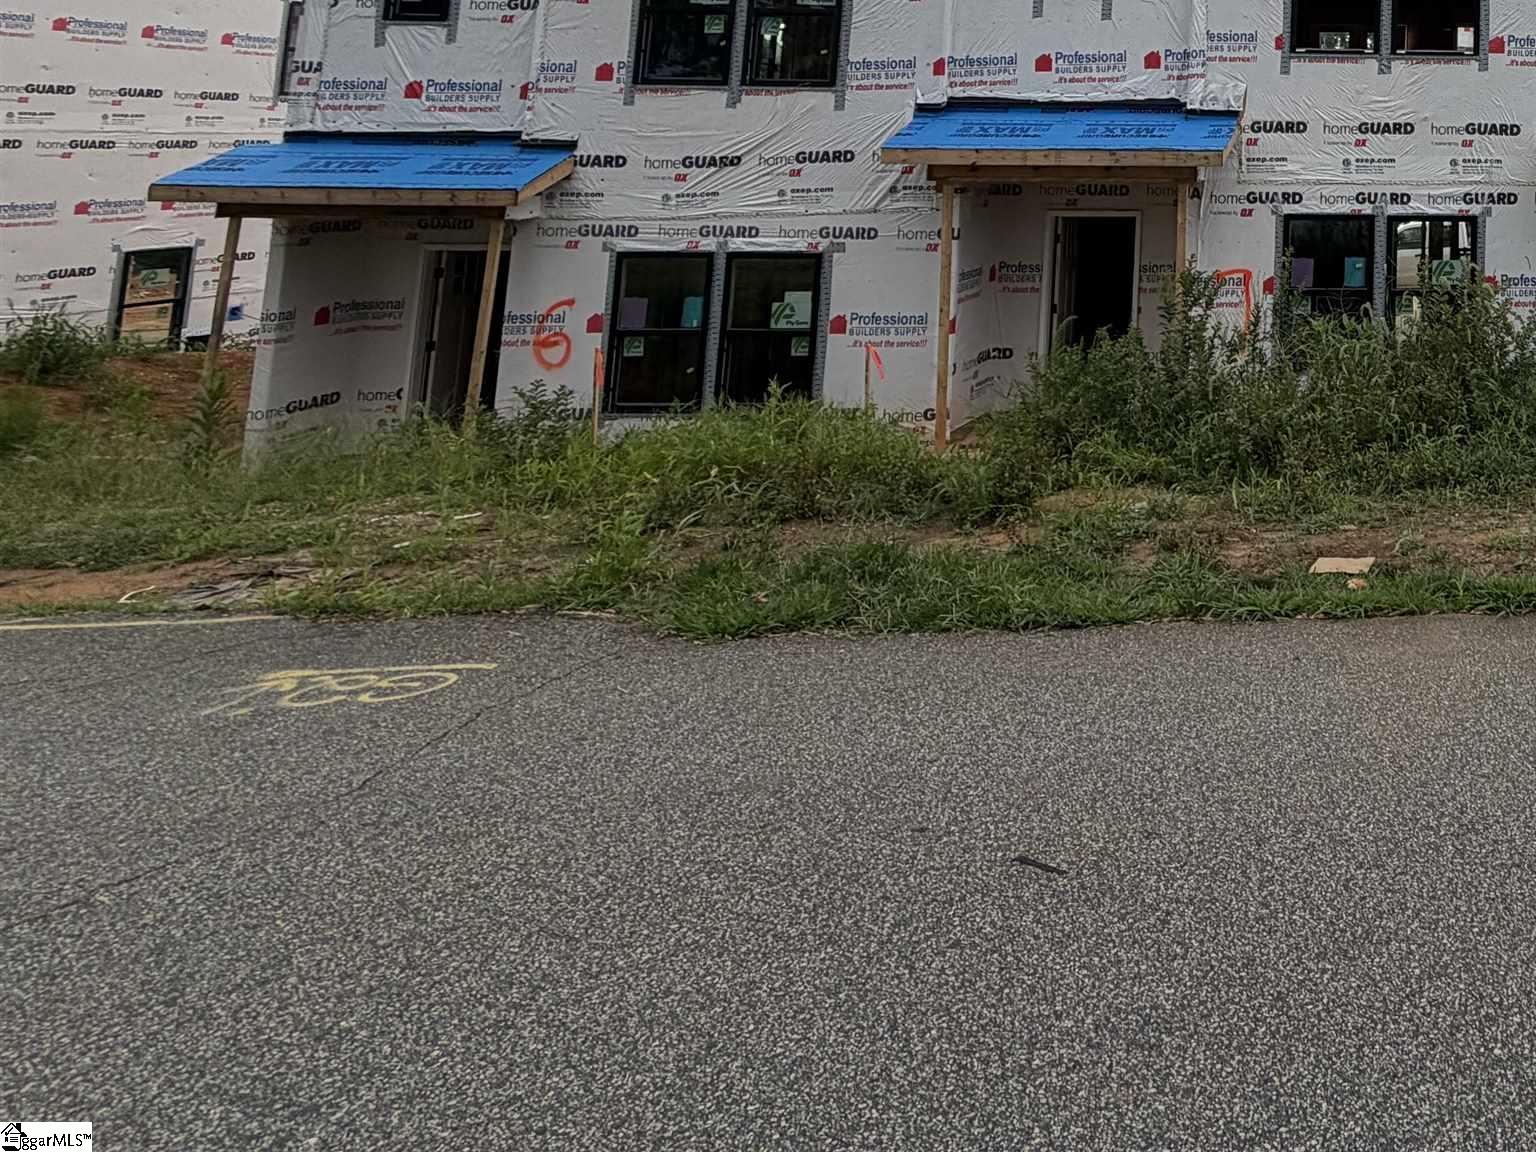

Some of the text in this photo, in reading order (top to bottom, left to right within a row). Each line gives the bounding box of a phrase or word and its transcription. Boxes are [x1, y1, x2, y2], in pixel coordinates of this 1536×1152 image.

[67, 16, 128, 31] Professional
[948, 54, 1017, 67] Professional
[1055, 65, 1127, 74] BUILDERS SUPPLY
[89, 87, 163, 99] homeGUARD
[426, 79, 502, 94] Professional
[174, 90, 239, 102] homeGUARD
[1323, 122, 1415, 137] homeGUARD
[1431, 123, 1521, 137] homeGUARD
[758, 150, 855, 165] homeGUARD
[89, 199, 146, 212] Professional
[1209, 192, 1303, 206] homeGUARD
[1319, 192, 1411, 206] homeGUARD
[1428, 193, 1518, 206] homeGUARD
[537, 224, 639, 238] homeGUARD
[658, 225, 759, 240] homeGUARD
[779, 226, 878, 241] homeGUARD
[850, 312, 928, 325] Professional
[849, 328, 927, 336] BUILDERS SUPPLY
